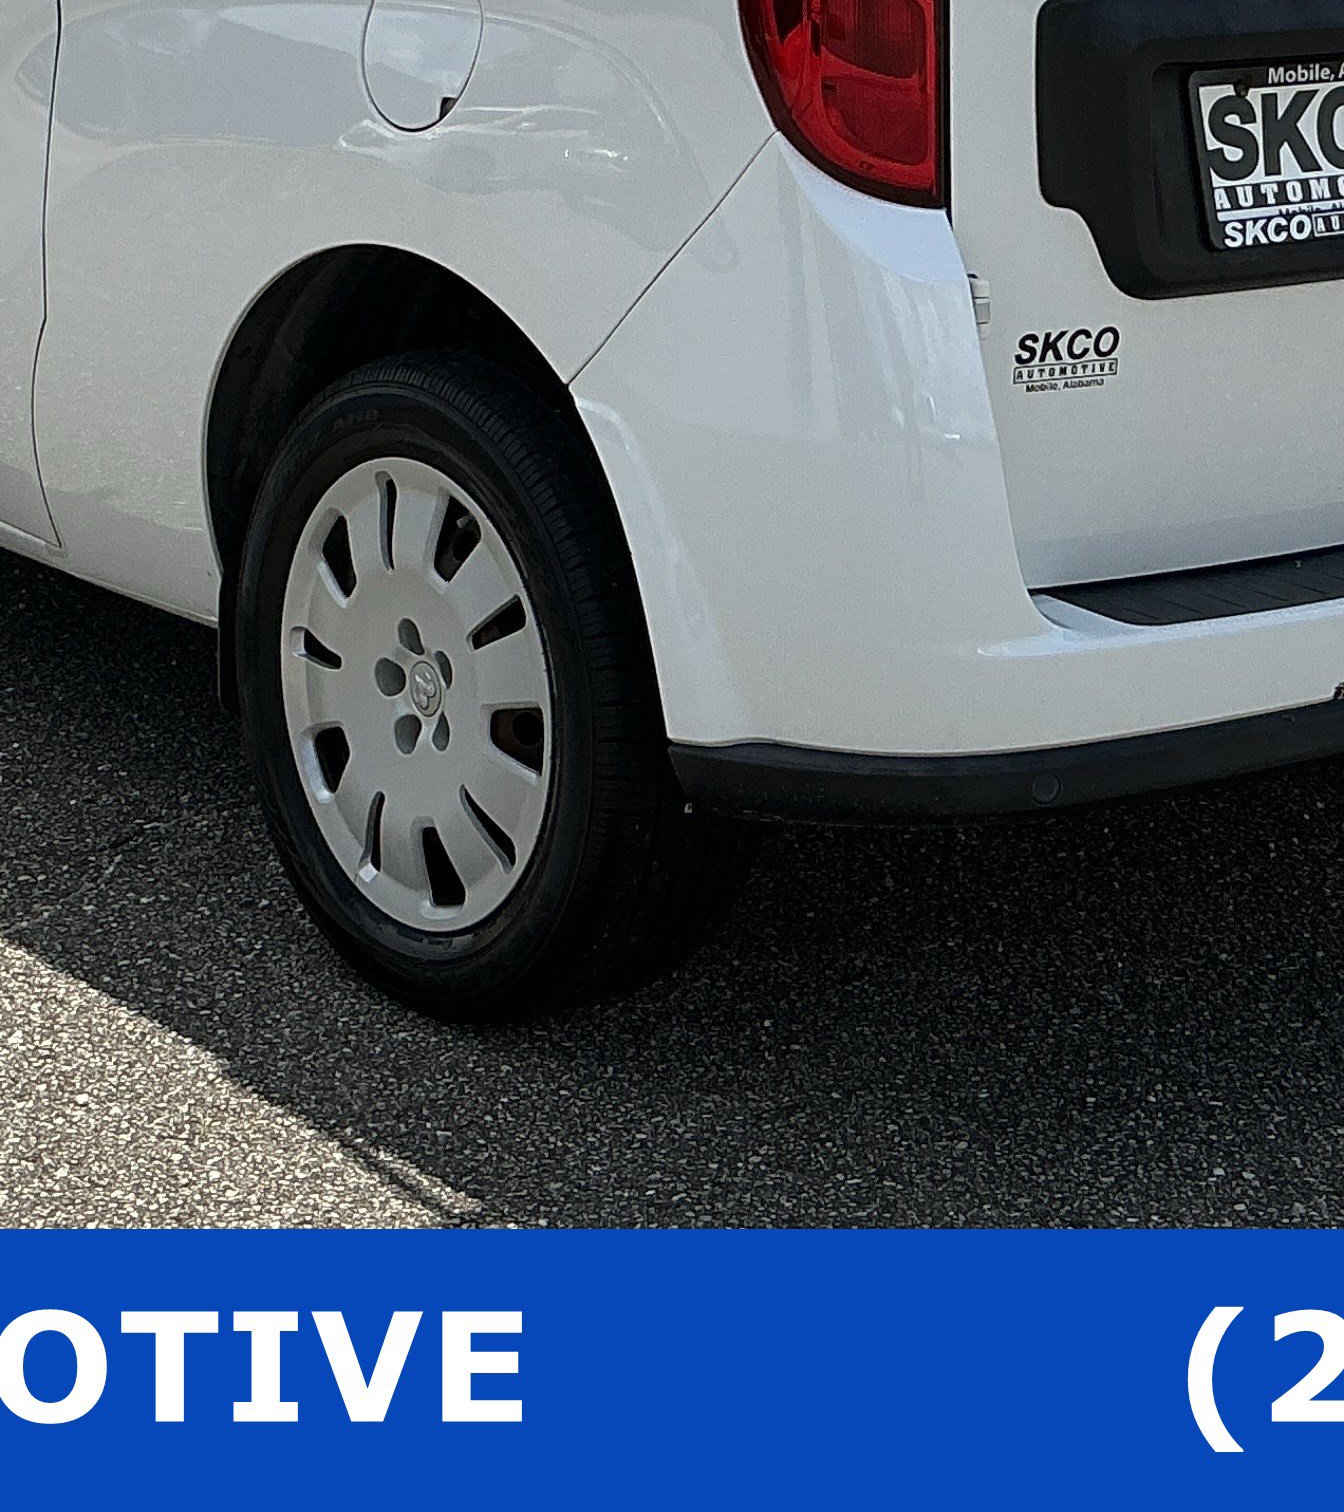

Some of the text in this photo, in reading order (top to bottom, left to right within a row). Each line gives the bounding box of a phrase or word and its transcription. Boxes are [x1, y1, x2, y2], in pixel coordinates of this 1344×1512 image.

[1267, 64, 1335, 85] Mobile,
[1223, 214, 1312, 249] SKCO
[1014, 326, 1120, 365] SKCO
[1016, 362, 1116, 380] AUTOMOTIVE
